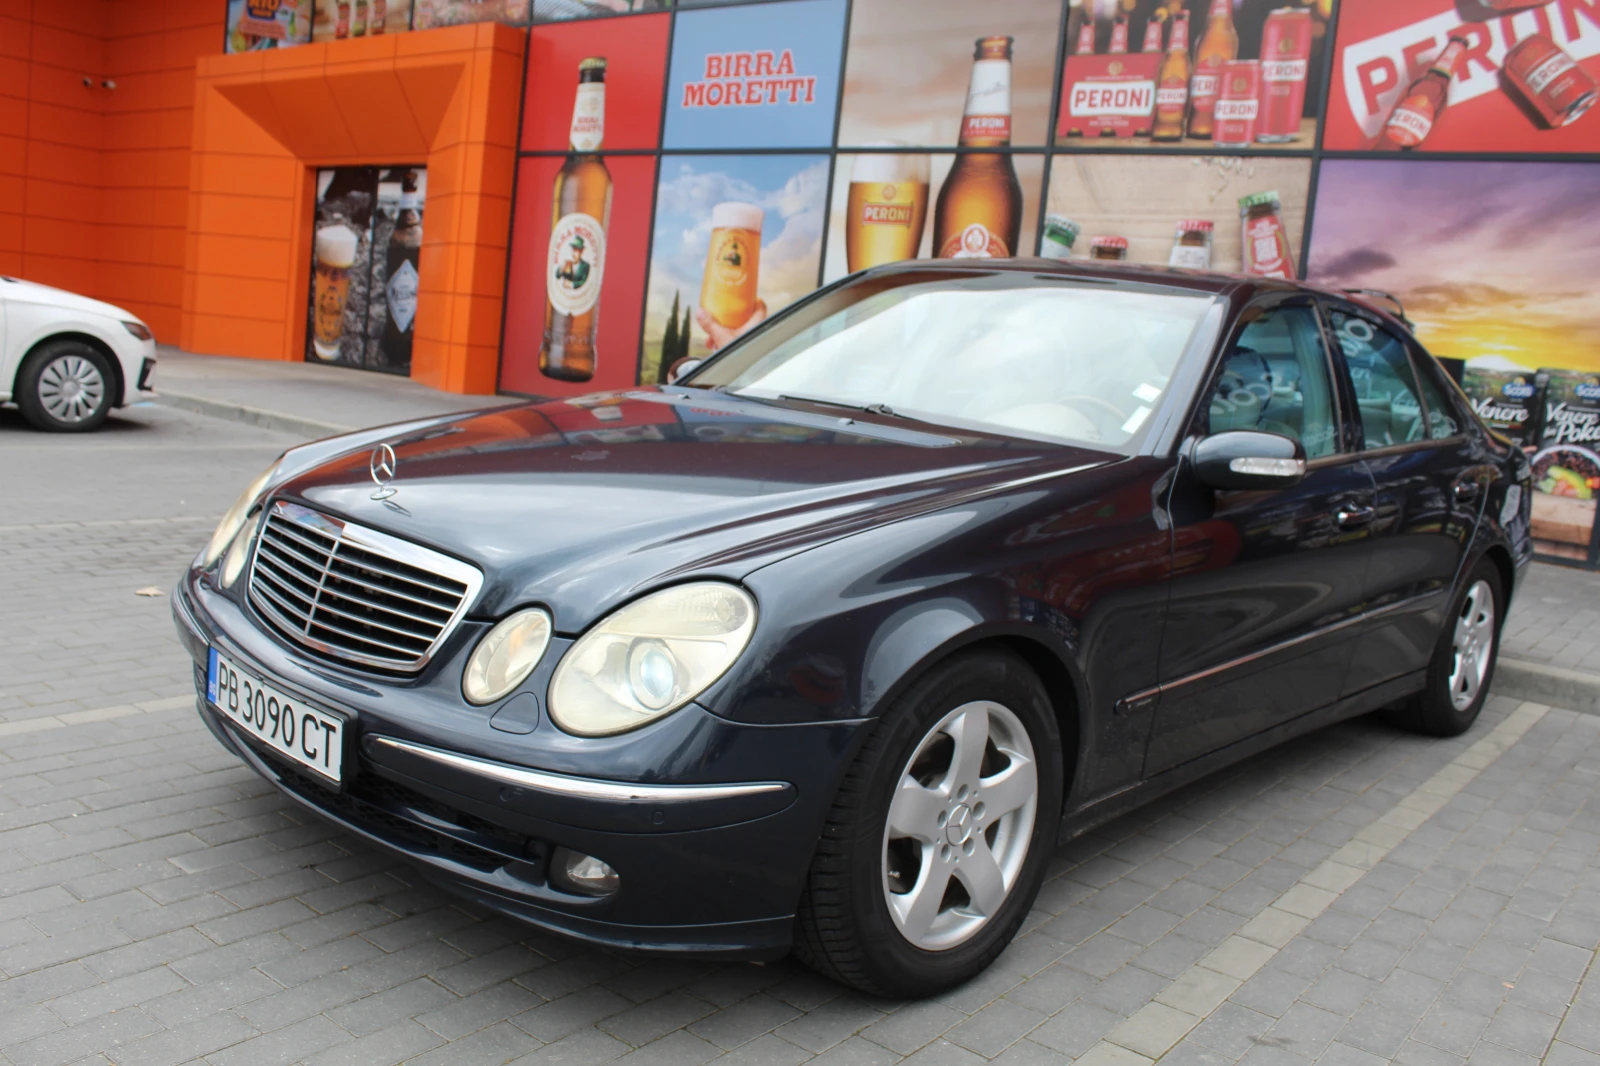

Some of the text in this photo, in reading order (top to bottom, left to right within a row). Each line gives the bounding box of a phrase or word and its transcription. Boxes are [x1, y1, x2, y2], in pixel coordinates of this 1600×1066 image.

[705, 50, 794, 79] BIRRA
[682, 77, 816, 107] MORETTI
[1074, 88, 1150, 109] PERONI
[968, 117, 1005, 129] PERONI
[864, 206, 911, 221] PERONI
[1471, 396, 1530, 422] Venere
[1546, 402, 1599, 426] Venere
[218, 661, 337, 768] PB 3090 CT
